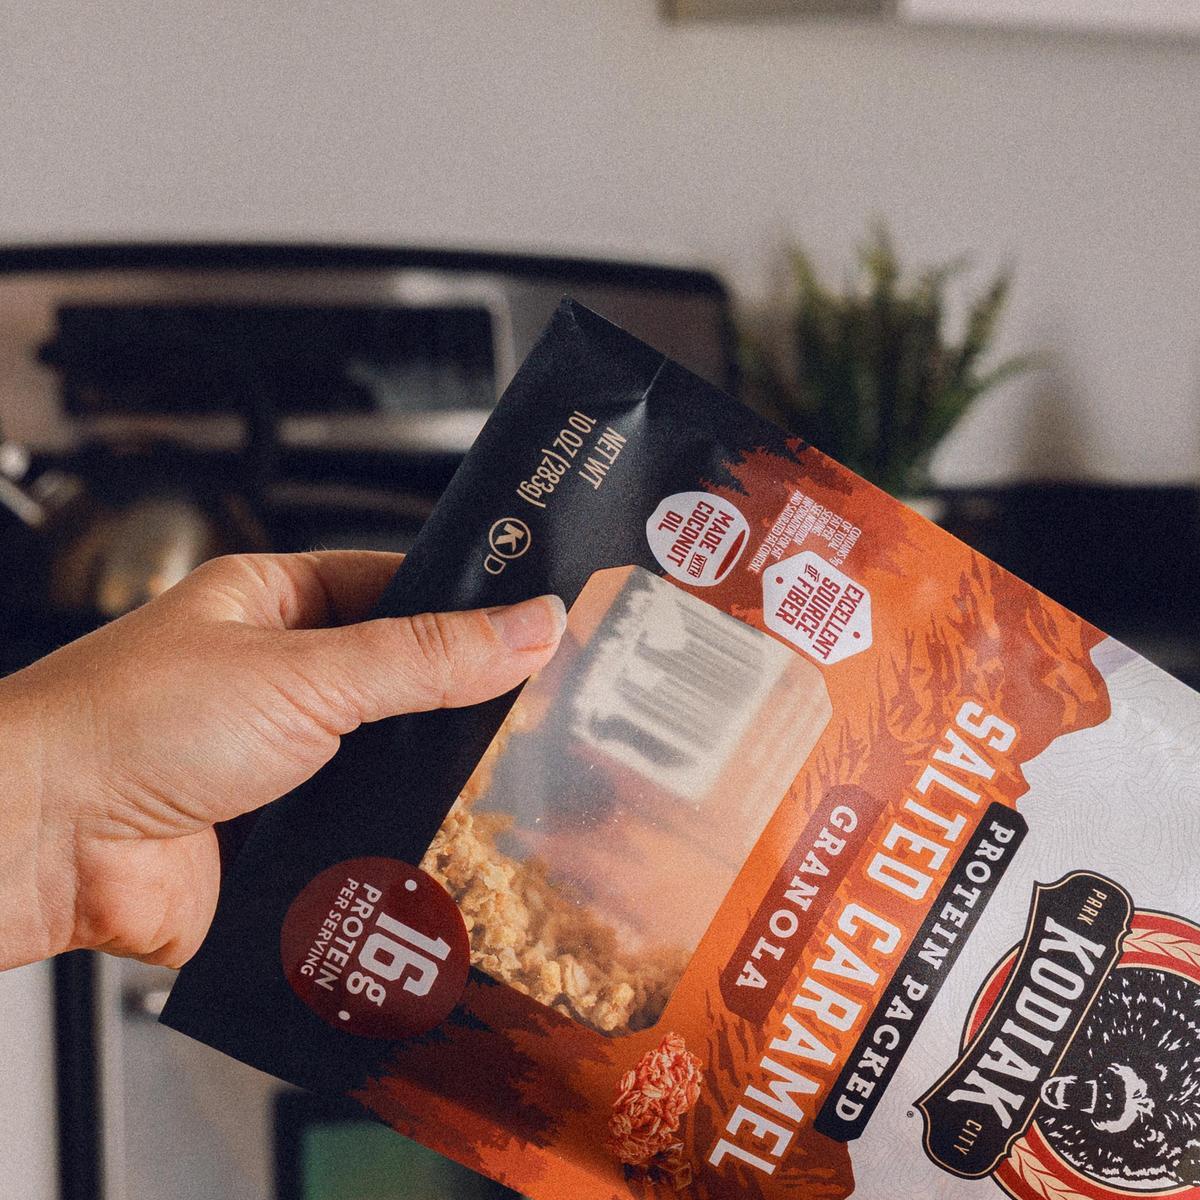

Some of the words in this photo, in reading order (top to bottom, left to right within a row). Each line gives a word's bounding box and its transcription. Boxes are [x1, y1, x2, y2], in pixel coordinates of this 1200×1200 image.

[568, 410, 596, 433] 10
[552, 429, 583, 458] OZ
[594, 426, 626, 464] NET
[516, 448, 571, 508] (283g)
[578, 457, 610, 489] WT
[788, 488, 805, 507] AND
[657, 510, 683, 532] OIL
[666, 500, 714, 567] COCONUT
[698, 510, 734, 553] MADE
[763, 532, 779, 547] FAT
[826, 528, 847, 551] TOTAL
[827, 513, 843, 529] FAT
[838, 519, 852, 533] OF
[768, 544, 784, 560] FAT
[775, 532, 792, 549] FOR
[834, 525, 862, 560] CONTAINS
[686, 552, 706, 578] WITH
[801, 563, 822, 583] OF
[775, 576, 814, 625] FIBER
[794, 576, 840, 638] SOURCE
[812, 583, 864, 659] EXCELLENT
[866, 701, 1016, 900] SALTED
[334, 877, 359, 909] PER
[735, 804, 858, 988] GRANOLA
[917, 820, 1015, 970] PROTEIN
[1077, 888, 1107, 925] PARK
[300, 909, 341, 976] SERVING
[314, 882, 382, 990] PROTEIN
[346, 911, 451, 1006] 16g
[709, 902, 902, 1174] CARAMEL
[946, 916, 1106, 1128] KODIAK
[835, 974, 929, 1120] PACKED
[953, 1119, 982, 1154] CITY
